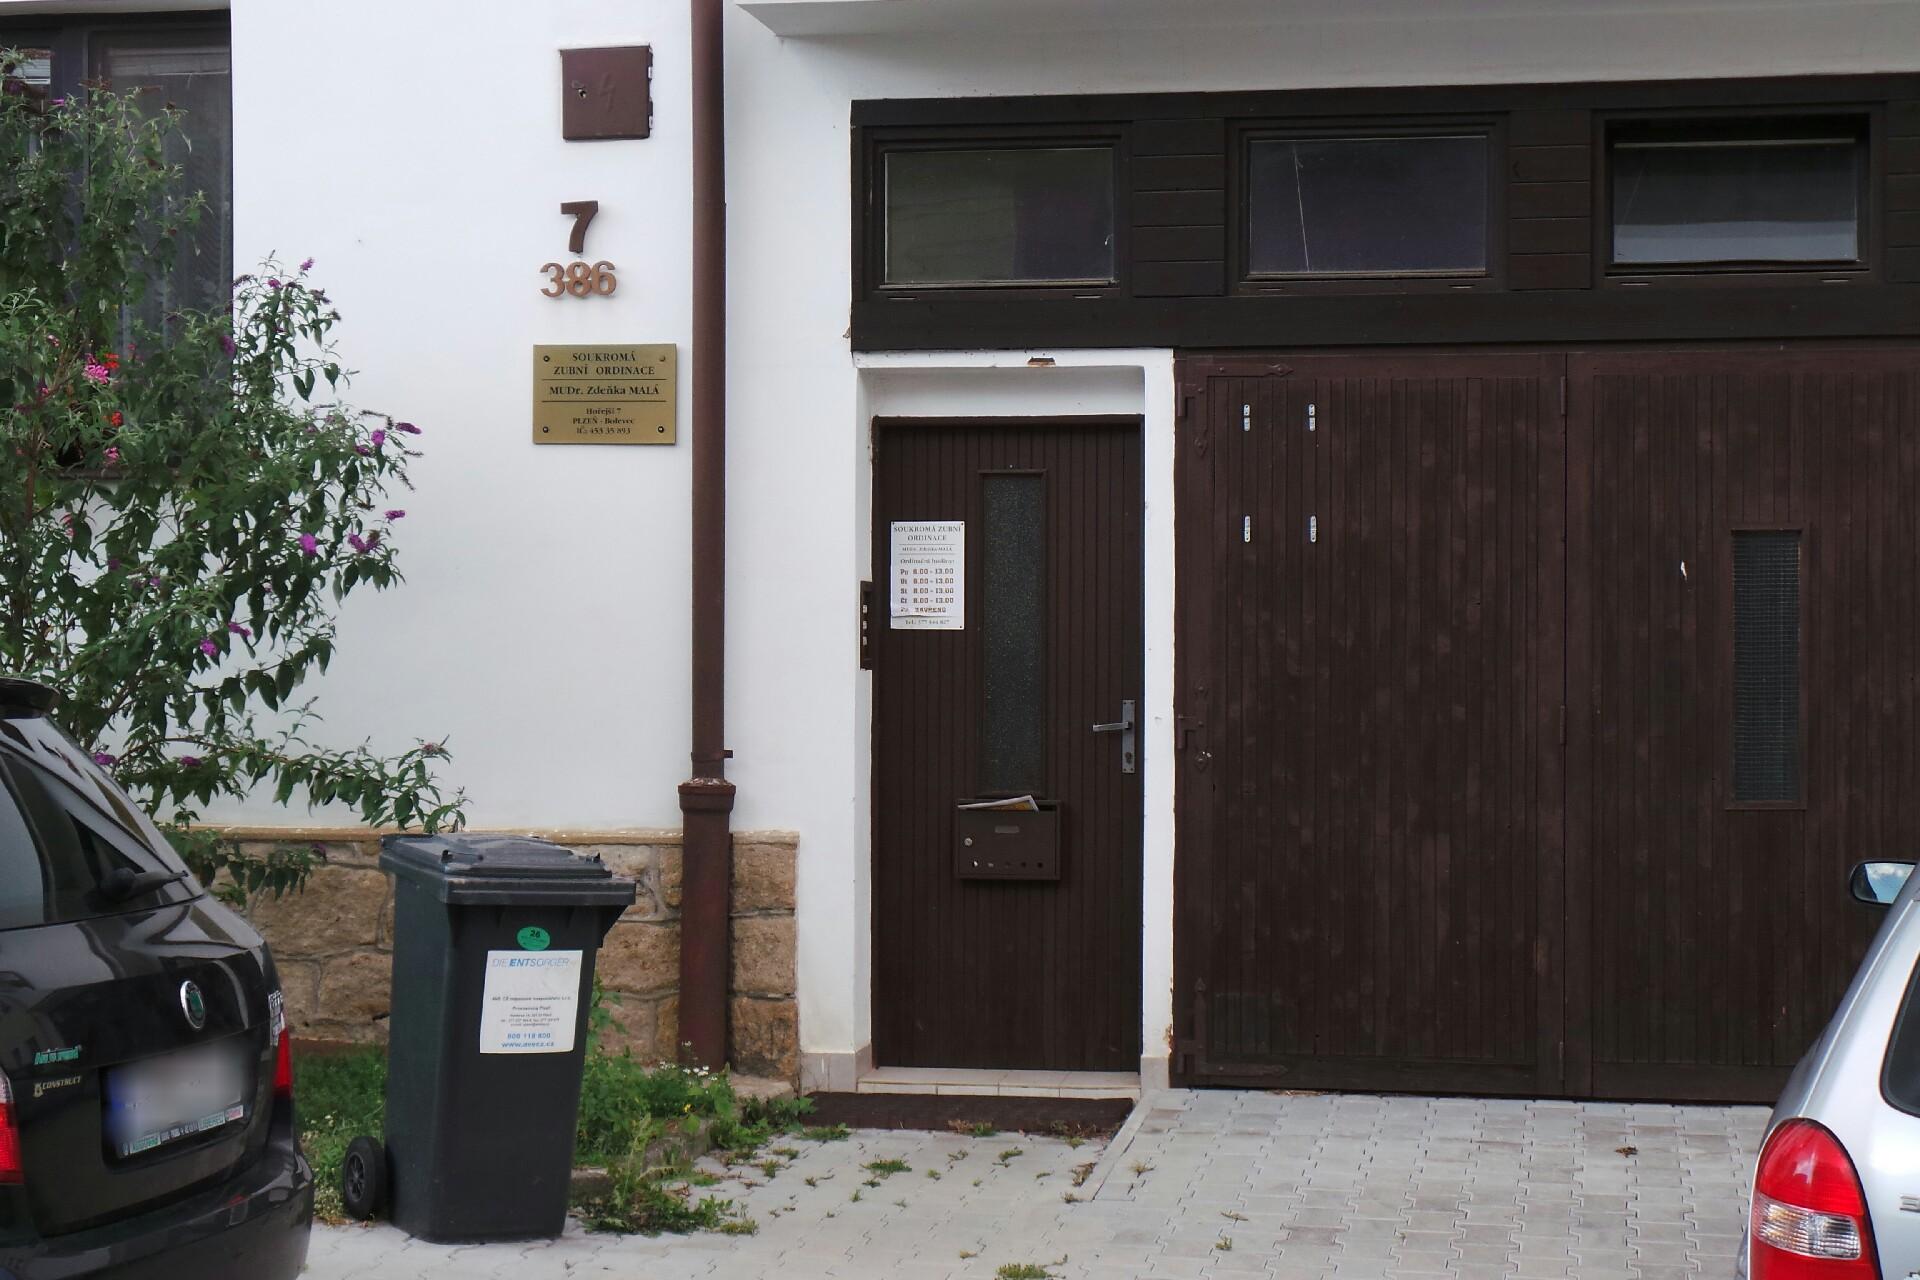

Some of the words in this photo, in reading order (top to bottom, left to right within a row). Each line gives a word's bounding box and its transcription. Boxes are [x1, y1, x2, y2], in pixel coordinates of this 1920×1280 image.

[560, 200, 598, 253] 7
[540, 261, 616, 297] 386
[572, 351, 636, 362] SOUKROMÁ
[553, 364, 588, 375] ZUBNÍ
[596, 366, 655, 375] ORDINACE
[549, 386, 583, 395] MUDr.
[587, 386, 626, 395] Zdeňka
[629, 384, 660, 395] MALÁ
[572, 416, 598, 425] PLZEŇ
